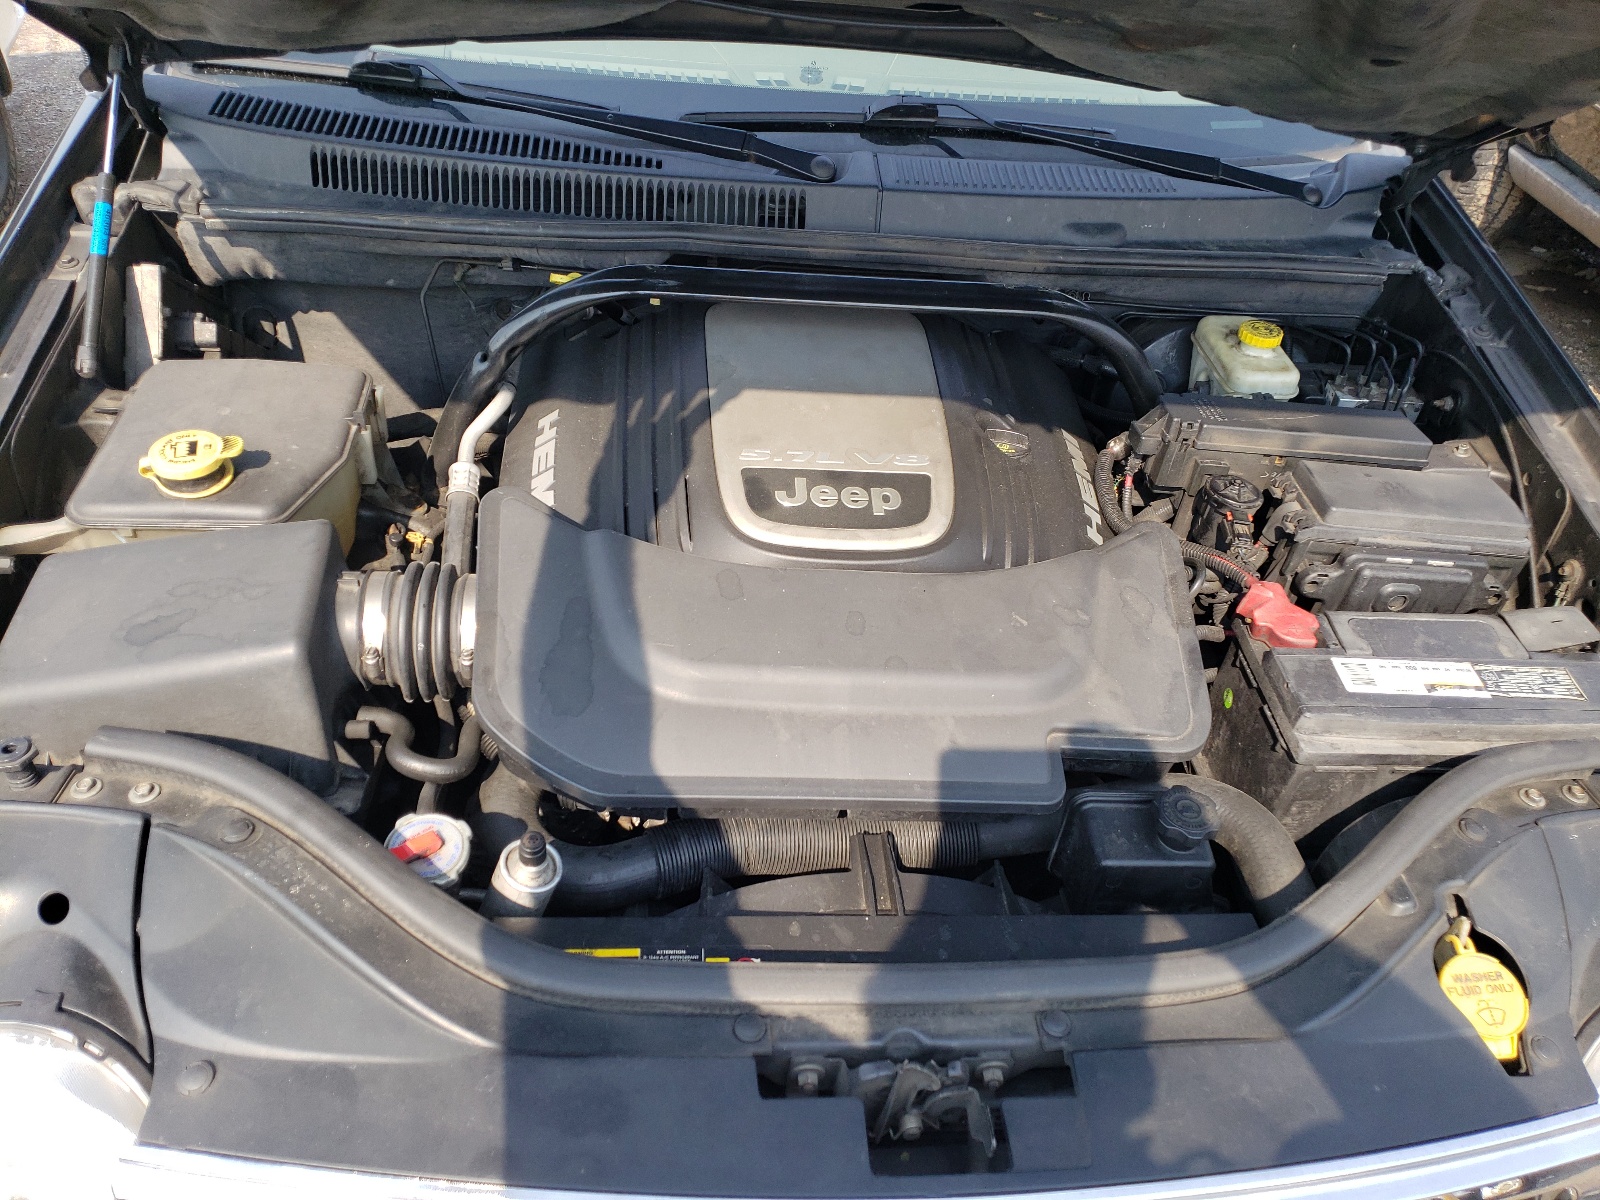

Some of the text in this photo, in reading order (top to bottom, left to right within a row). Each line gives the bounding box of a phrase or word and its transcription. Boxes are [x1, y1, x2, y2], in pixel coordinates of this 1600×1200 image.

[531, 408, 560, 508] HEM
[738, 449, 930, 466] 5.7L V8
[775, 477, 902, 516] Jeep
[1061, 428, 1104, 546] HEMI
[1446, 983, 1515, 997] FLUID ONLY
[1451, 971, 1504, 983] WASHER
